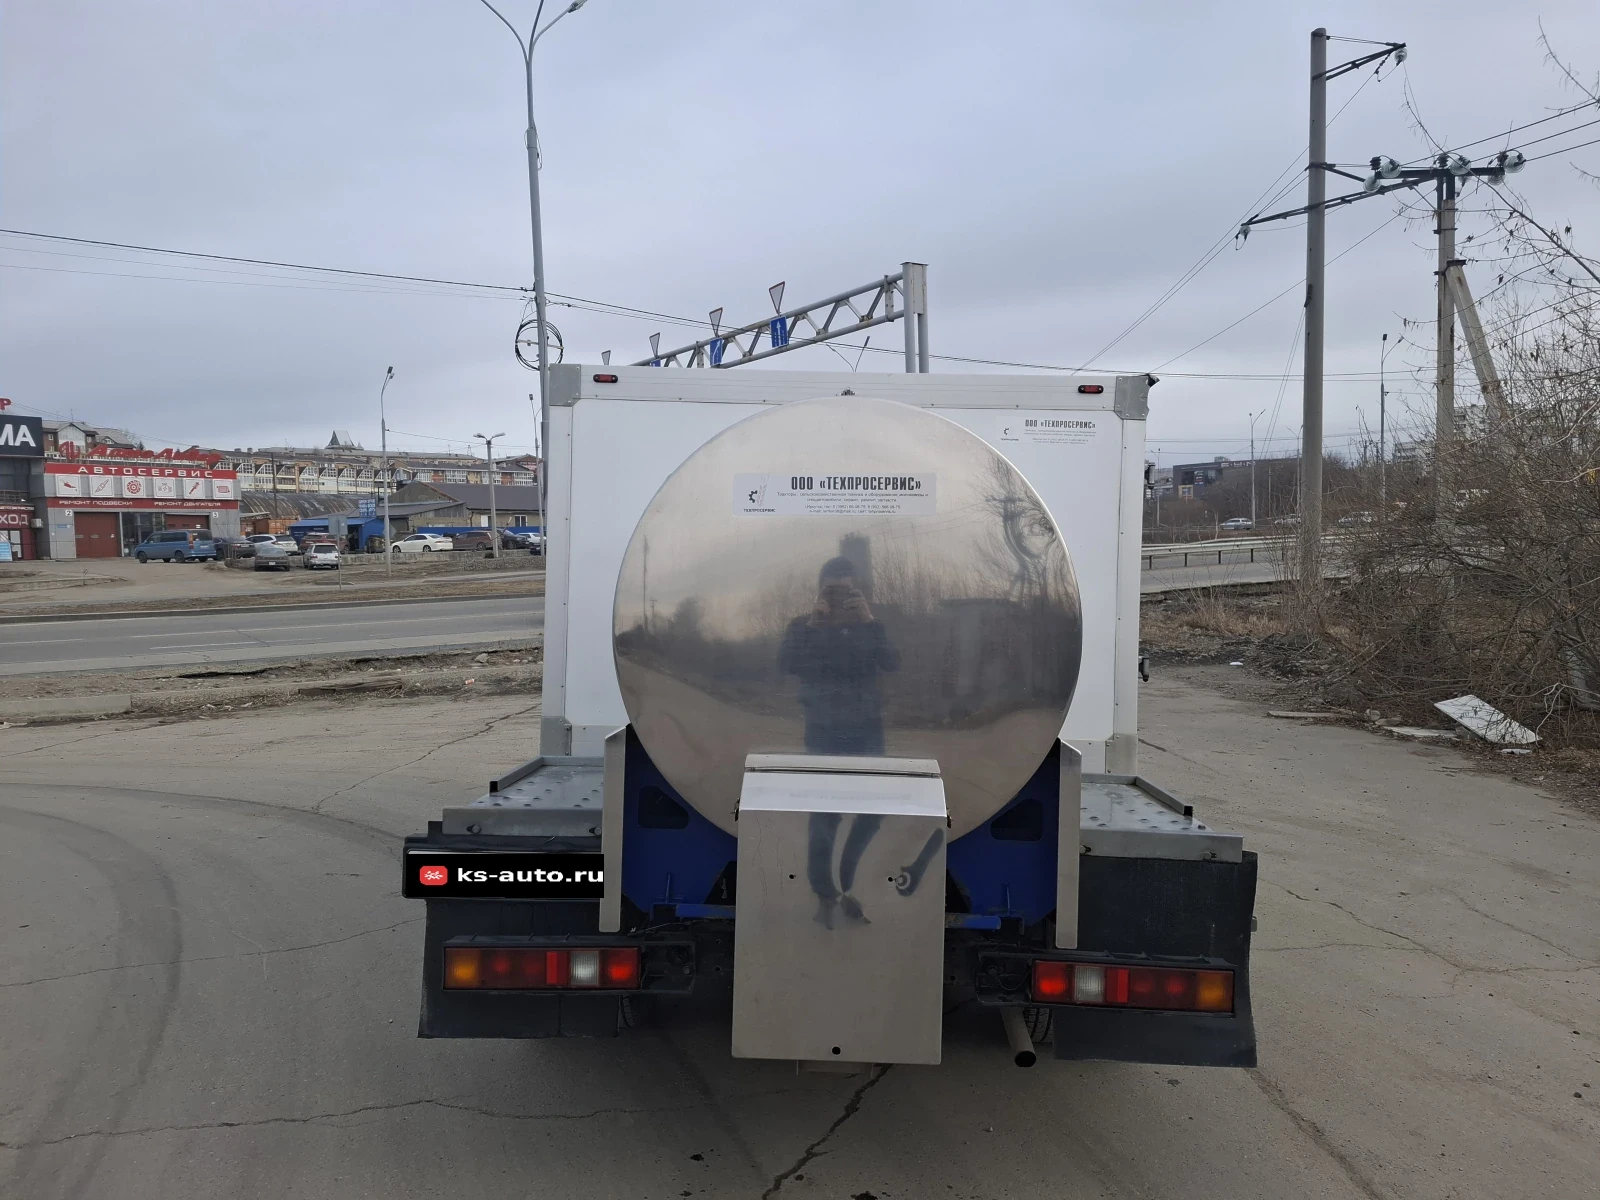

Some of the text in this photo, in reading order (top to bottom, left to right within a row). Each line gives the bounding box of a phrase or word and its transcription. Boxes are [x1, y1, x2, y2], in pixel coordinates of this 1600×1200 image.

[1025, 419, 1096, 429] ООО «ТЕХПРОСЕРВИС»
[78, 466, 214, 478] АВТОСЕРВИС
[791, 476, 922, 491] ООО «ТЕХПРОСЕРВИС»
